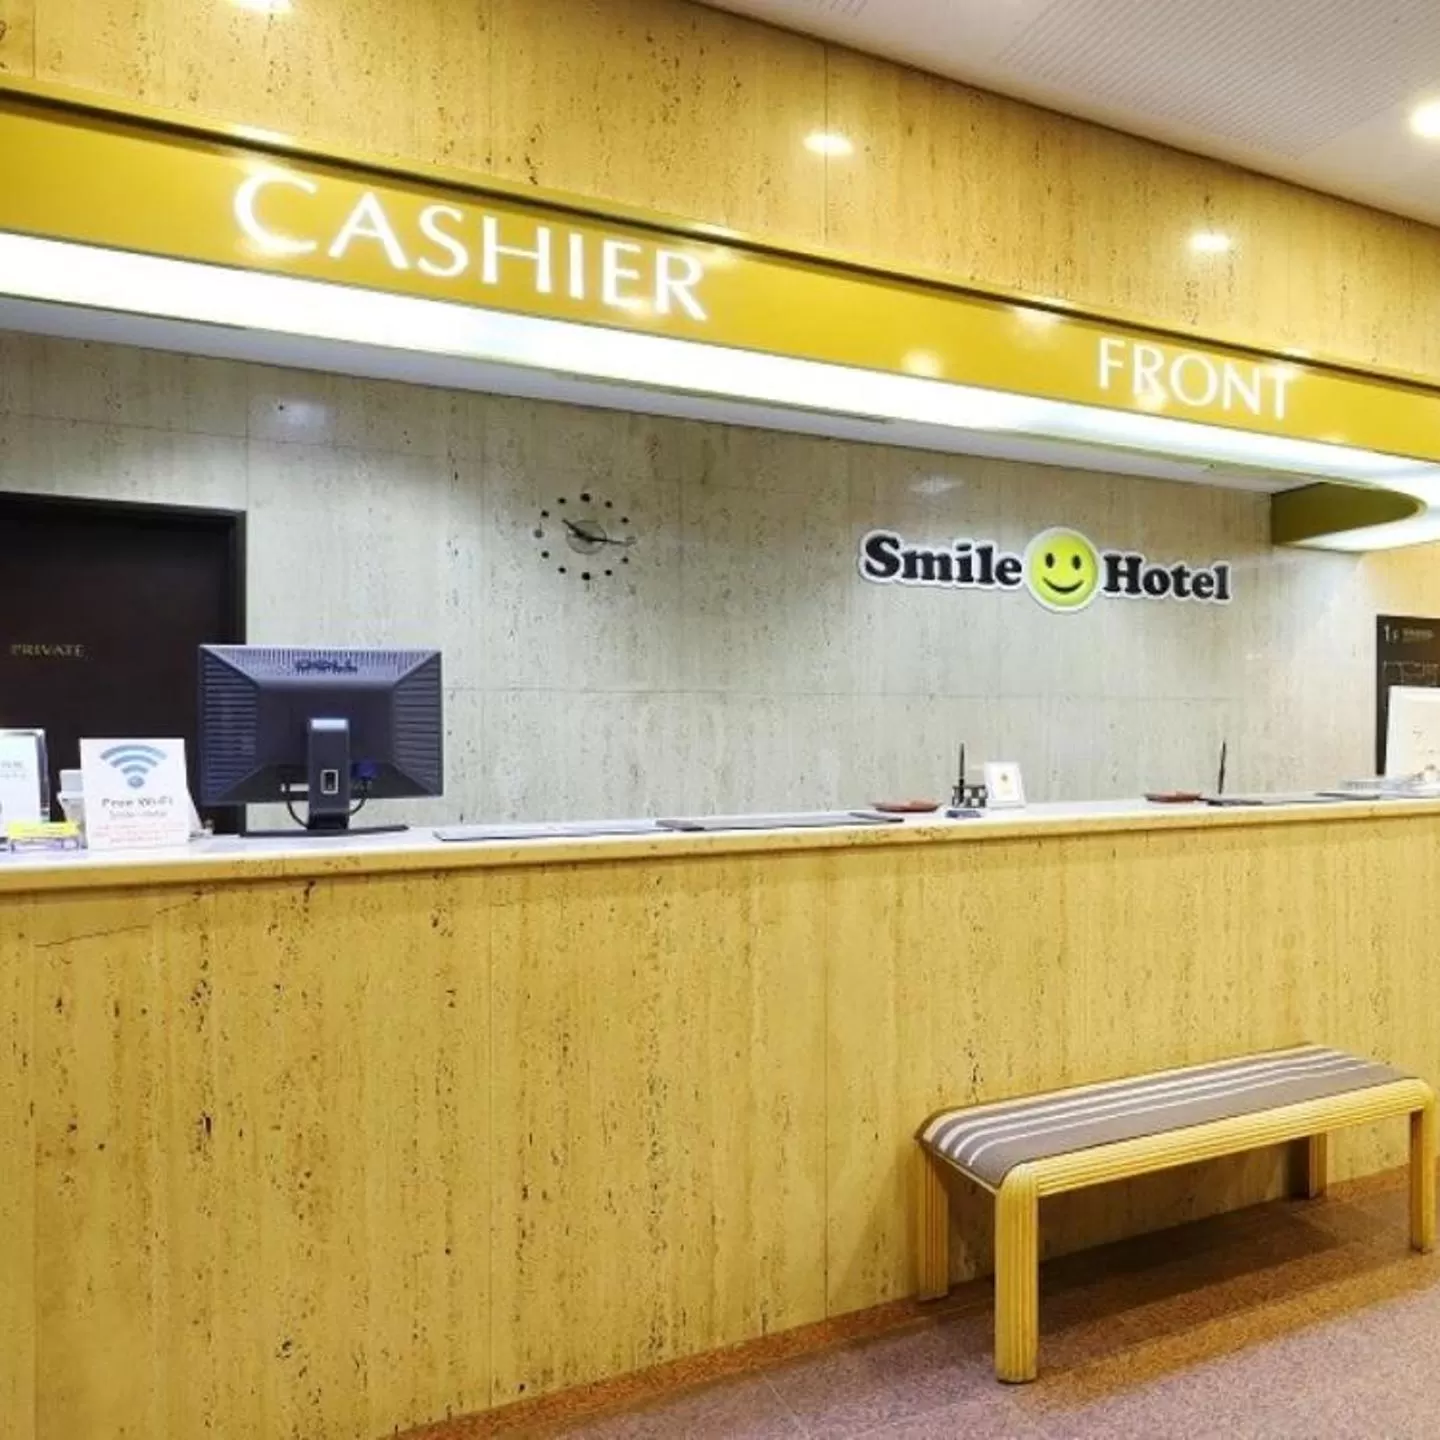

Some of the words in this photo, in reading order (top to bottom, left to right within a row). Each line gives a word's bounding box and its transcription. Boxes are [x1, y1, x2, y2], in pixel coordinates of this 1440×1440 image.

[233, 171, 708, 321] CASHIER
[1099, 336, 1297, 420] FRONT
[864, 534, 1023, 585] Smile
[1103, 552, 1231, 600] Hotel
[10, 643, 85, 657] PRIVATE
